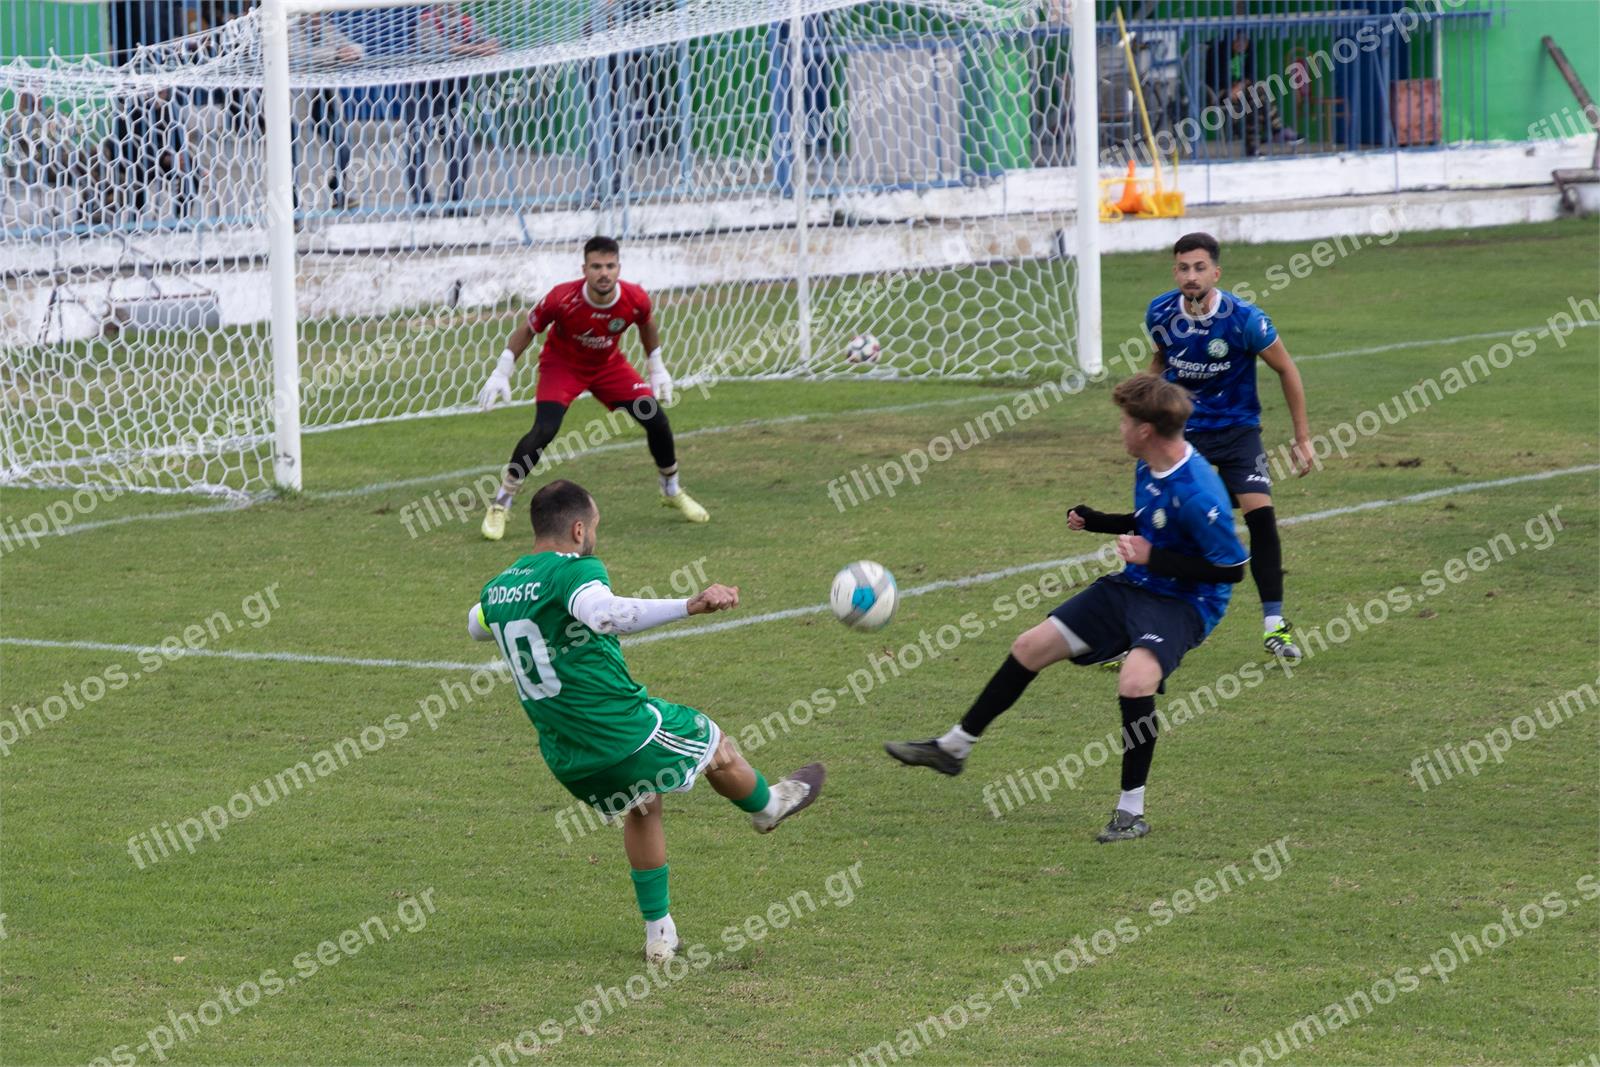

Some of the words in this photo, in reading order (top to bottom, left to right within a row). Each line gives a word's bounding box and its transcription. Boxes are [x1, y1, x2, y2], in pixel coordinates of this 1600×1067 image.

[1168, 356, 1208, 372] ENERGY
[1207, 360, 1231, 373] GAS
[524, 582, 541, 601] FC
[489, 619, 562, 701] 10
